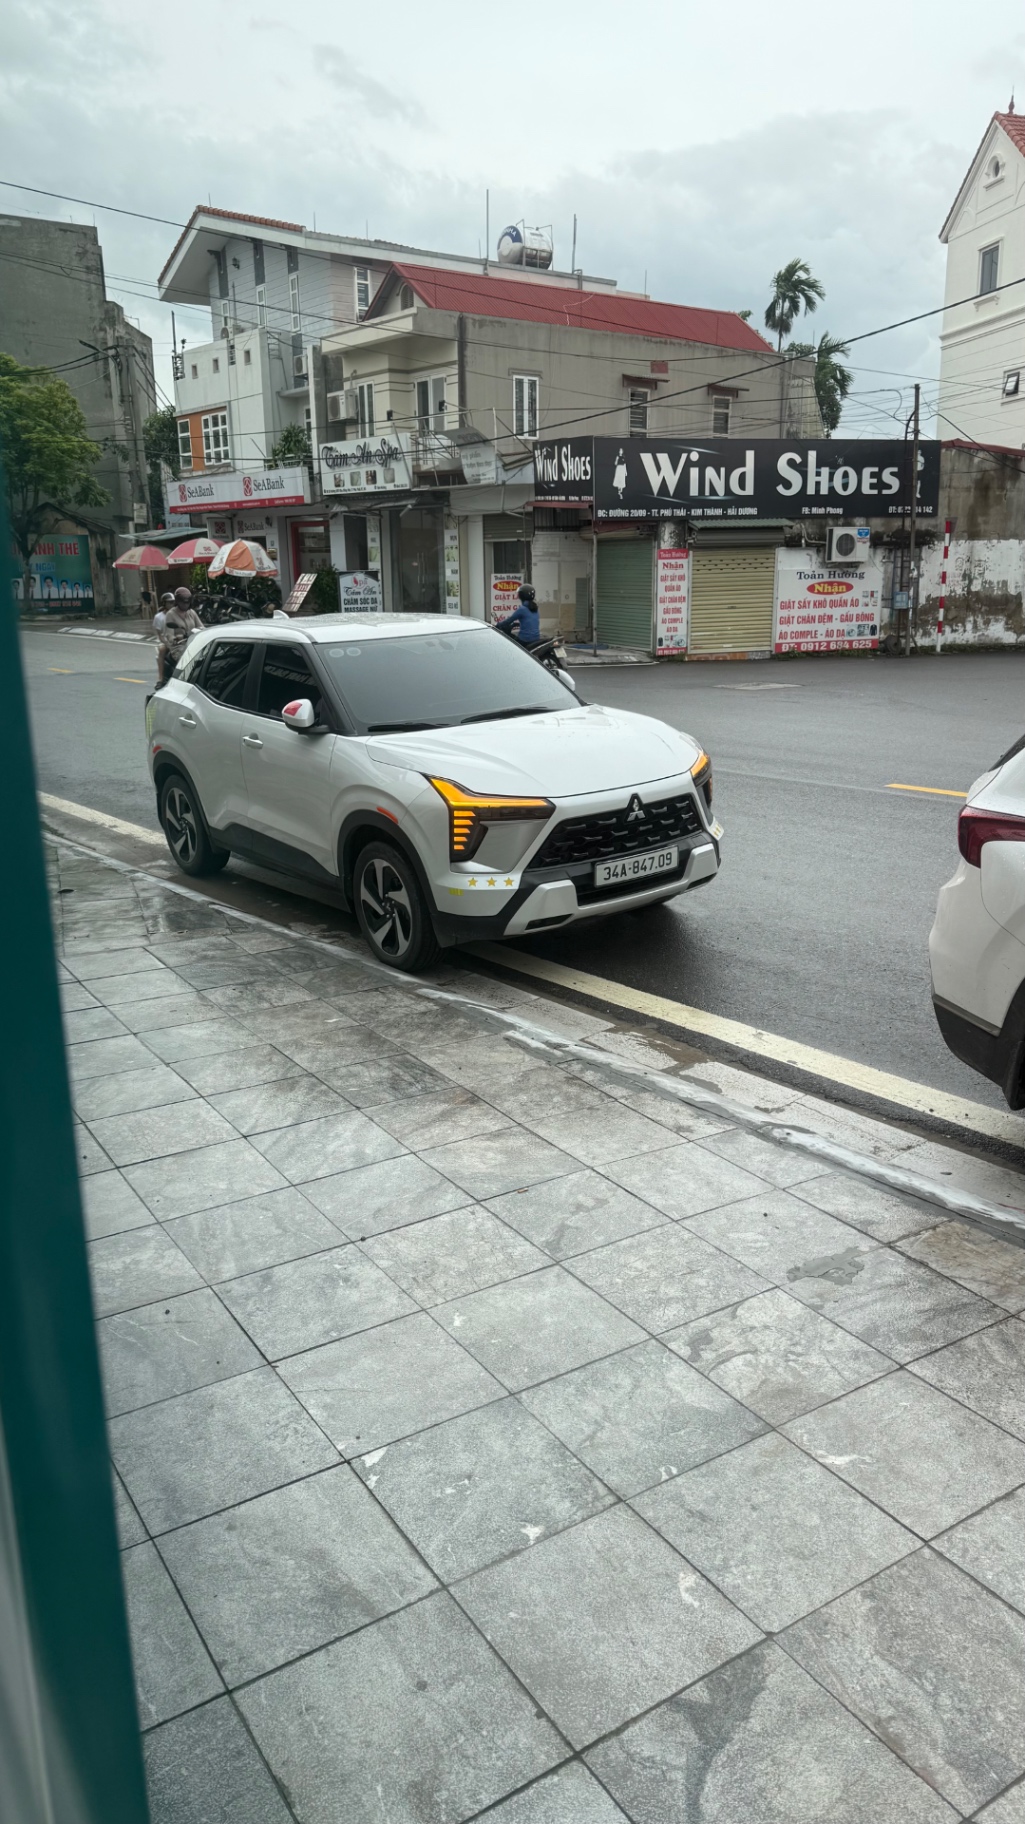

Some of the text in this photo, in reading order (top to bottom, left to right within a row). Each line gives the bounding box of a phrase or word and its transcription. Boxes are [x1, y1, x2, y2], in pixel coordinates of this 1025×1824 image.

[253, 476, 285, 492] SeABank
[187, 484, 215, 499] SeABank
[630, 509, 646, 517] 20/09
[826, 506, 844, 515] Phong
[662, 562, 684, 570] Nhận
[796, 570, 824, 580] Toản
[814, 582, 846, 595] Nhận
[780, 599, 795, 612] GIẶT
[797, 597, 811, 609] SẤY
[779, 614, 795, 627] GIẶT
[818, 612, 833, 626] ĐỆM
[840, 611, 855, 623] GẤU
[856, 612, 874, 622] BÔNG
[778, 630, 788, 640] ÁO
[790, 630, 818, 640] COMPLE
[781, 640, 872, 652] ĐT: 0912 684 625
[603, 852, 672, 881] 34A-847.09
